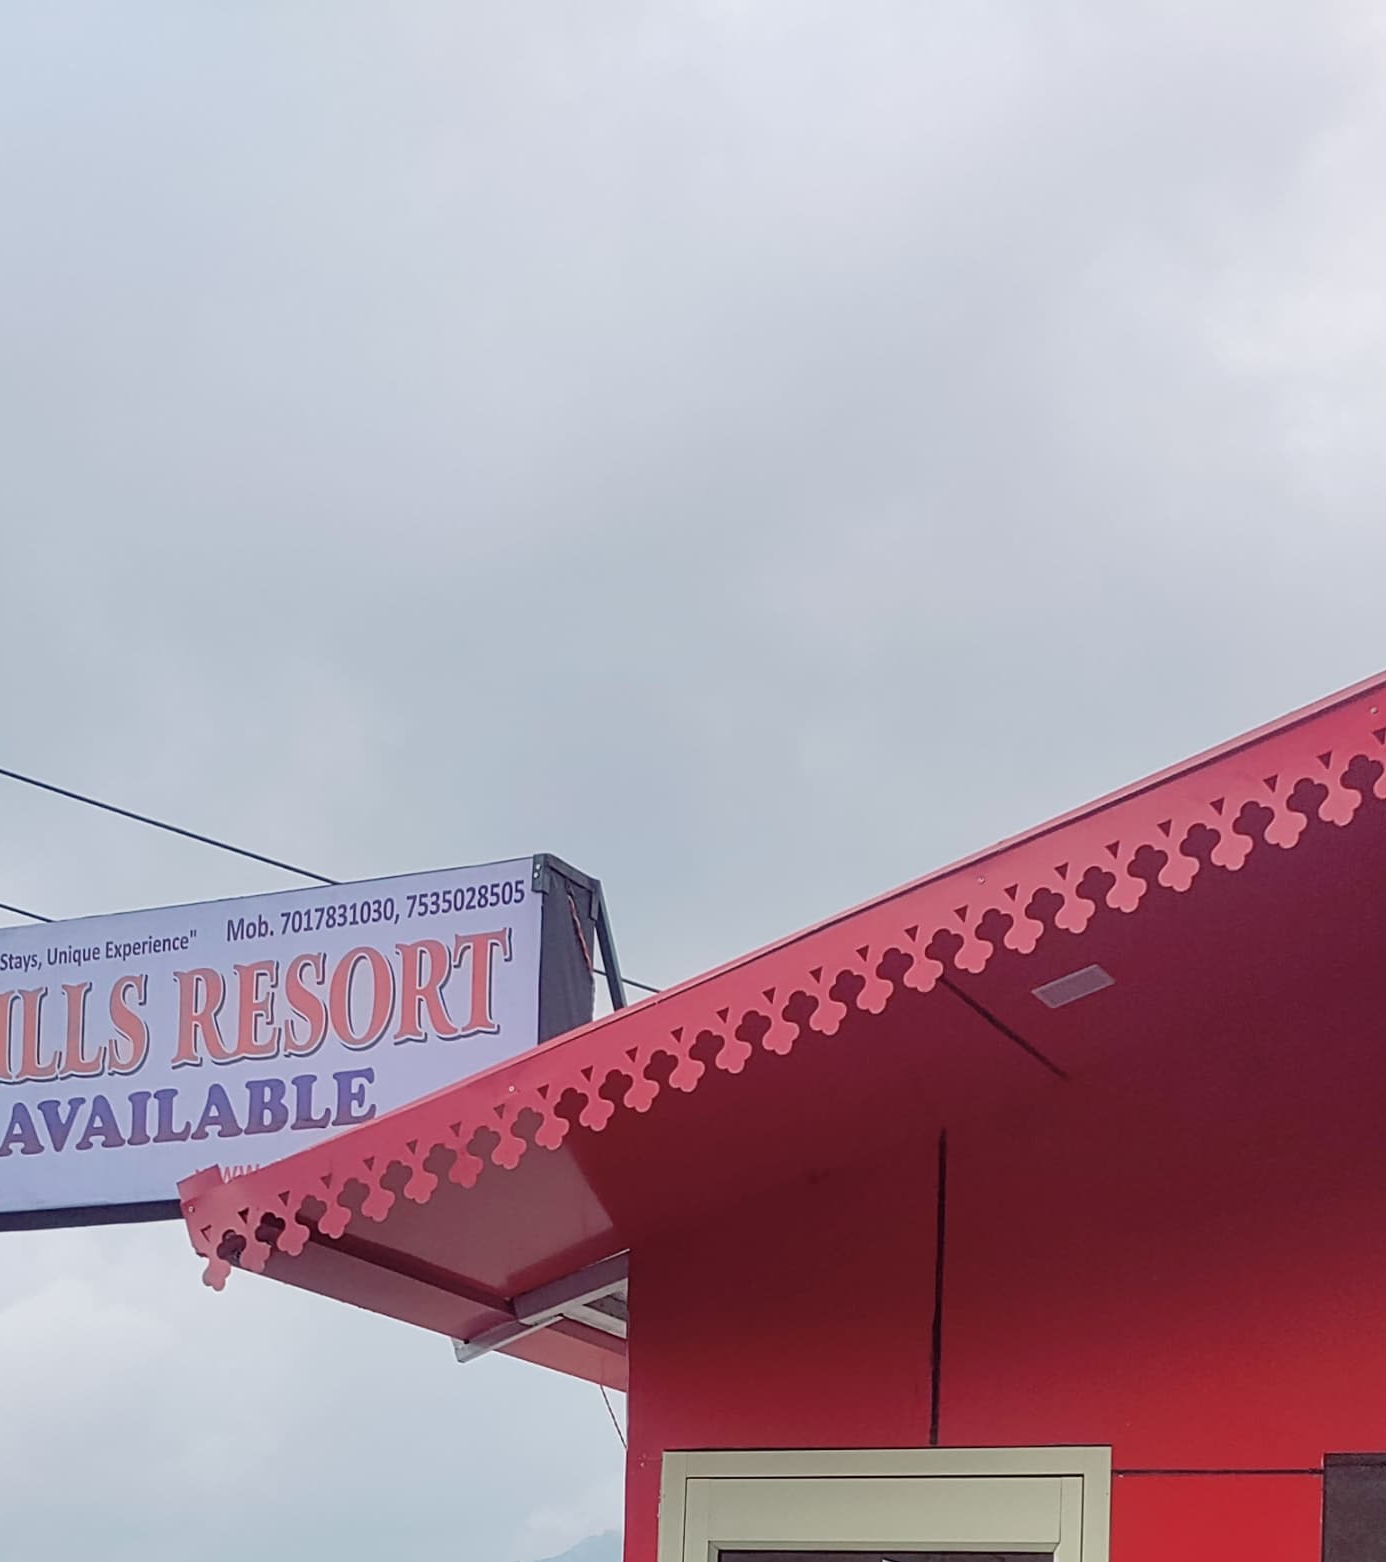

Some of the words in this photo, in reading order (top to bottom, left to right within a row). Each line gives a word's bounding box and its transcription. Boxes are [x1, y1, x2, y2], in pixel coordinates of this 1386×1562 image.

[226, 915, 274, 942] Mob.
[281, 898, 400, 935] 7017831030,
[407, 880, 525, 918] 7535028505
[0, 952, 42, 971] Stays,
[47, 939, 101, 967] Unique
[105, 929, 197, 962] Experience"
[171, 928, 513, 1067] RESORT
